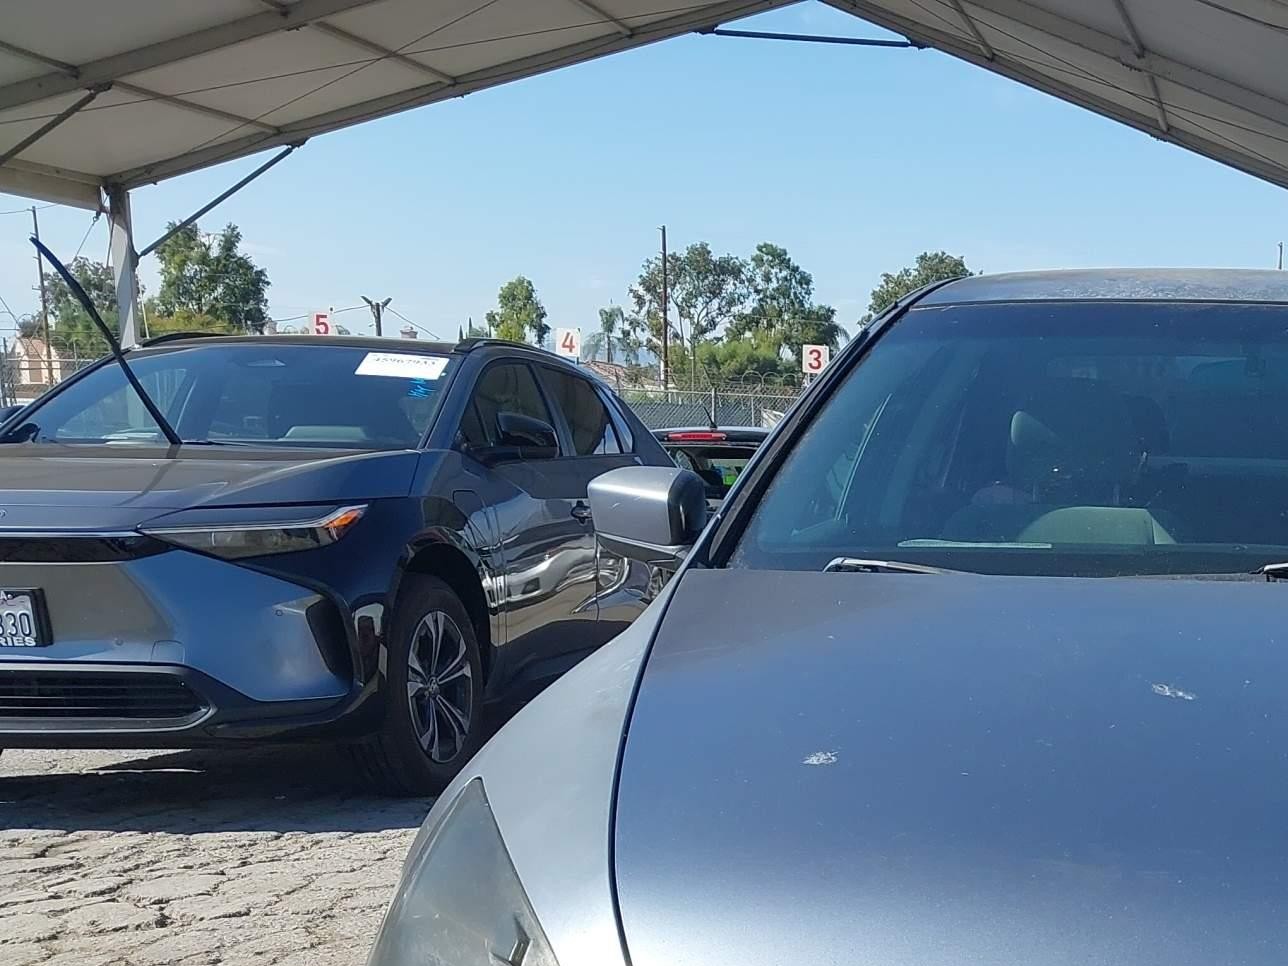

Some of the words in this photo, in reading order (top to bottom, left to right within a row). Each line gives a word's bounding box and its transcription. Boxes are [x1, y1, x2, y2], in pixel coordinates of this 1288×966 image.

[315, 314, 329, 335] 5
[561, 332, 576, 353] 4
[808, 349, 821, 370] 3
